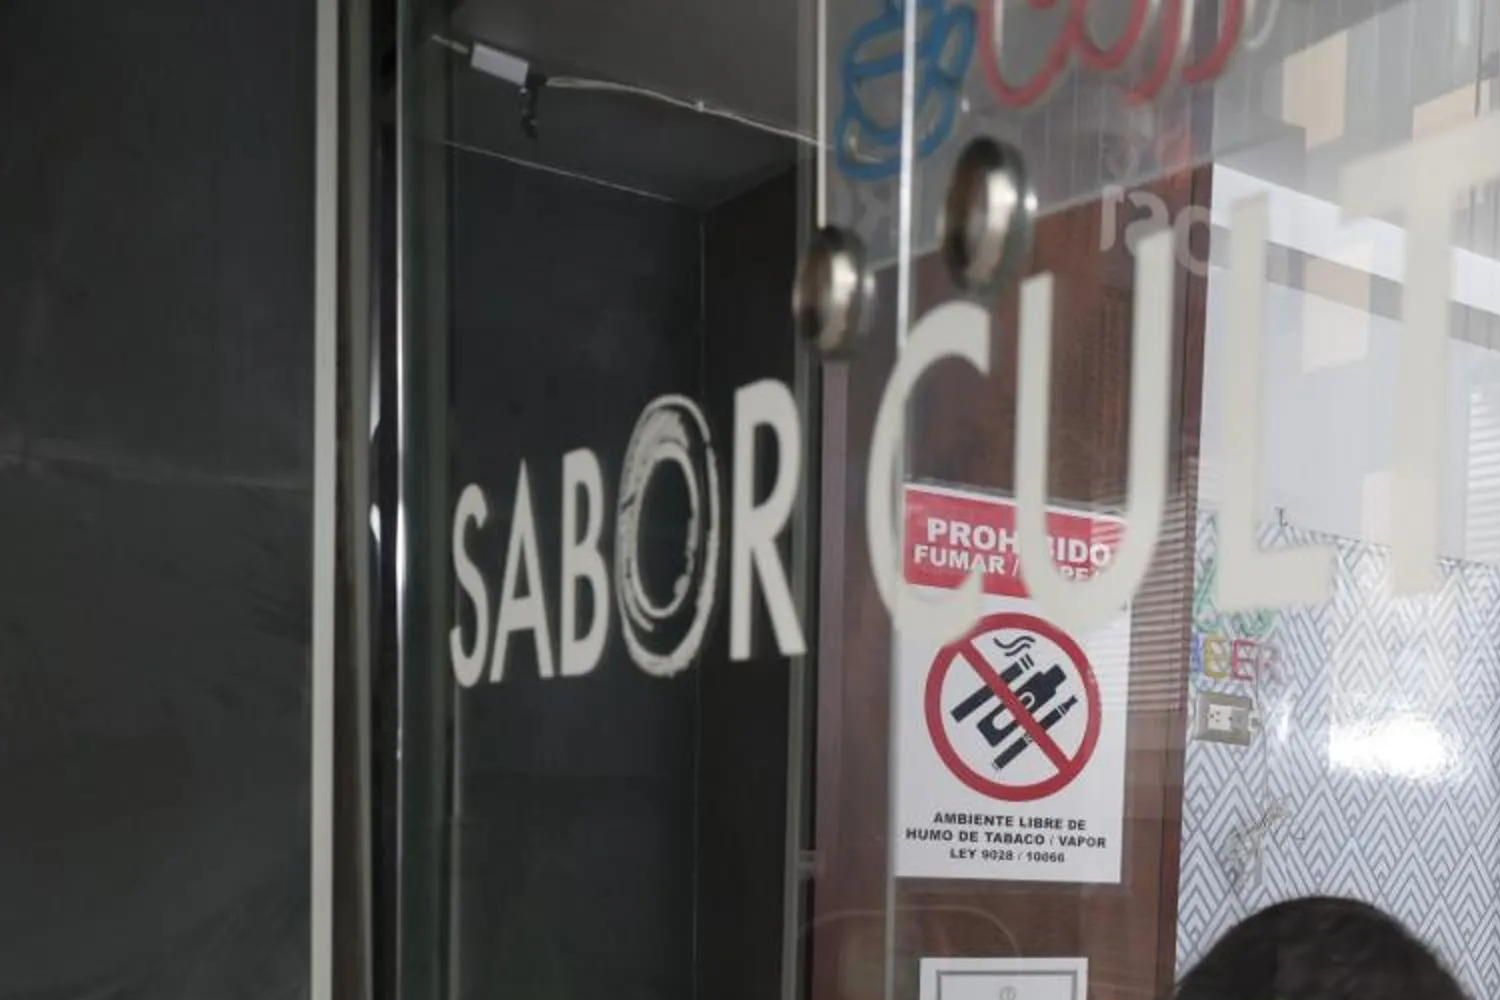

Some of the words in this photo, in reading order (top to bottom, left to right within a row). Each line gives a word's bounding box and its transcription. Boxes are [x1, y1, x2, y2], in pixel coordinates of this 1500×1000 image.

[449, 378, 806, 689] SABOR
[913, 543, 1005, 575] FUMAR
[933, 812, 1014, 828] AMBIENTE
[1019, 816, 1062, 830] LIBRE
[1067, 818, 1087, 831] DE
[905, 827, 953, 842] HUMO
[959, 830, 979, 843] DE
[984, 831, 1045, 845] TABACO
[1058, 834, 1107, 849] VAPOR
[949, 848, 976, 860] LEY
[981, 849, 1014, 862] 9028
